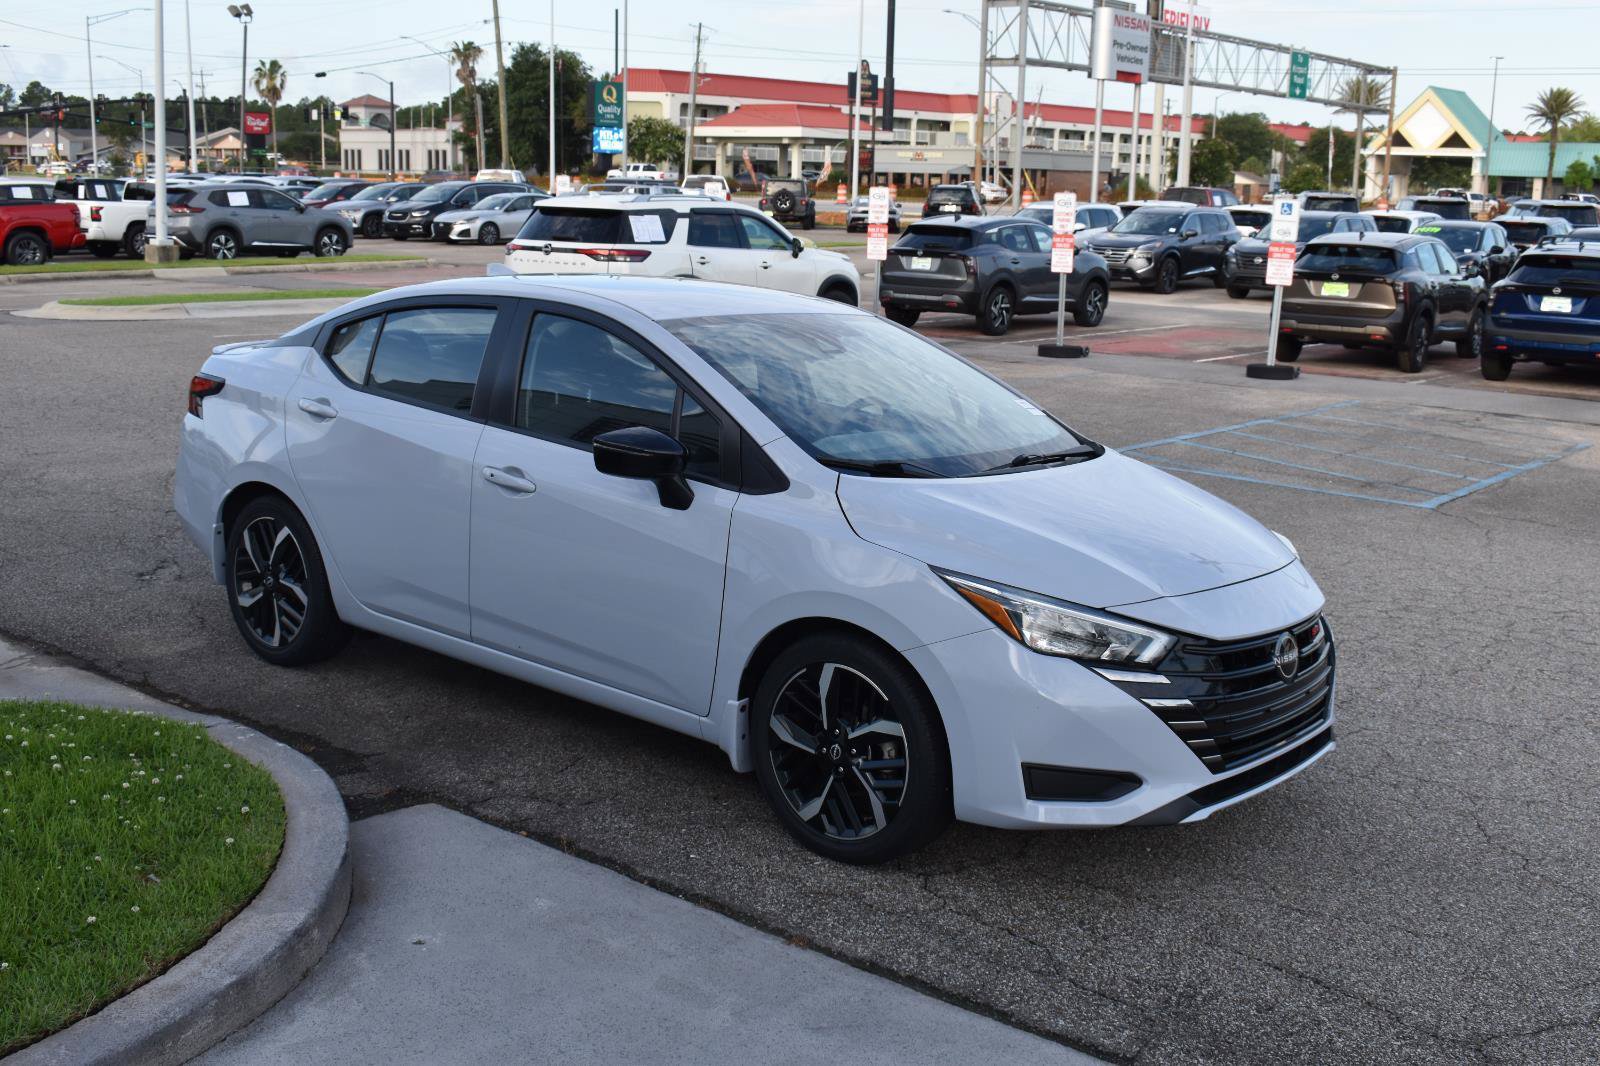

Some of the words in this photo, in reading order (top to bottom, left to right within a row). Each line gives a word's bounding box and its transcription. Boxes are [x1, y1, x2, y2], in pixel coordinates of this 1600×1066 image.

[1114, 14, 1149, 32] NISSAN
[1113, 40, 1148, 53] Pre-Owned
[1116, 53, 1143, 65] Vehicles
[597, 103, 621, 115] Quality
